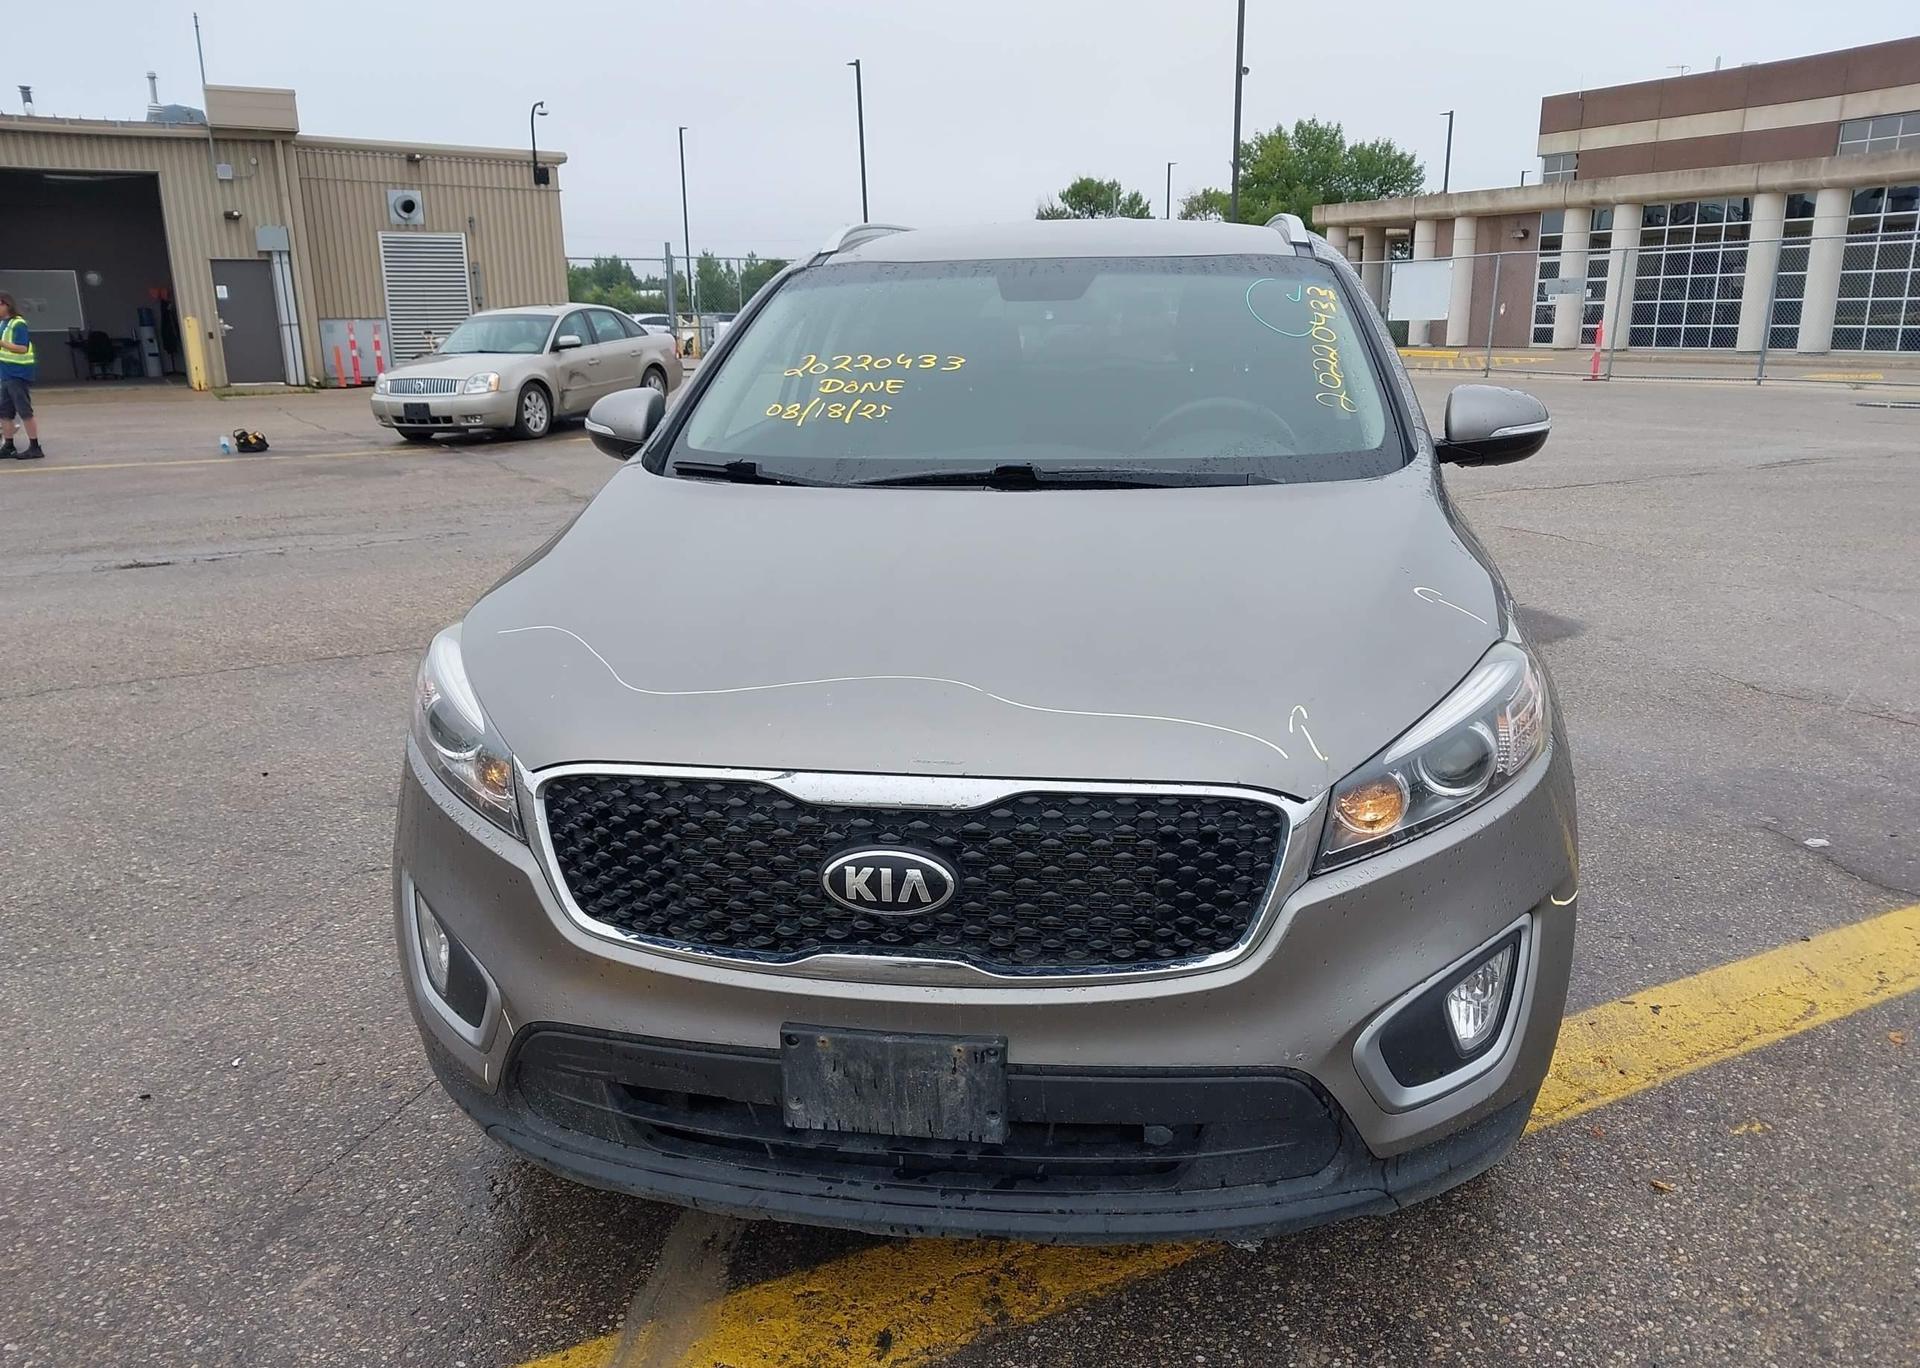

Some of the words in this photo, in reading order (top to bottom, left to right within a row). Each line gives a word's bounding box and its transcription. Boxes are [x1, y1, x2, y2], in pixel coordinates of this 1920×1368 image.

[1306, 286, 1358, 413] 20220433
[783, 353, 966, 377] 20220433
[818, 378, 905, 394] DONE
[766, 398, 892, 427] 08/18/25
[844, 866, 932, 903] KIA
